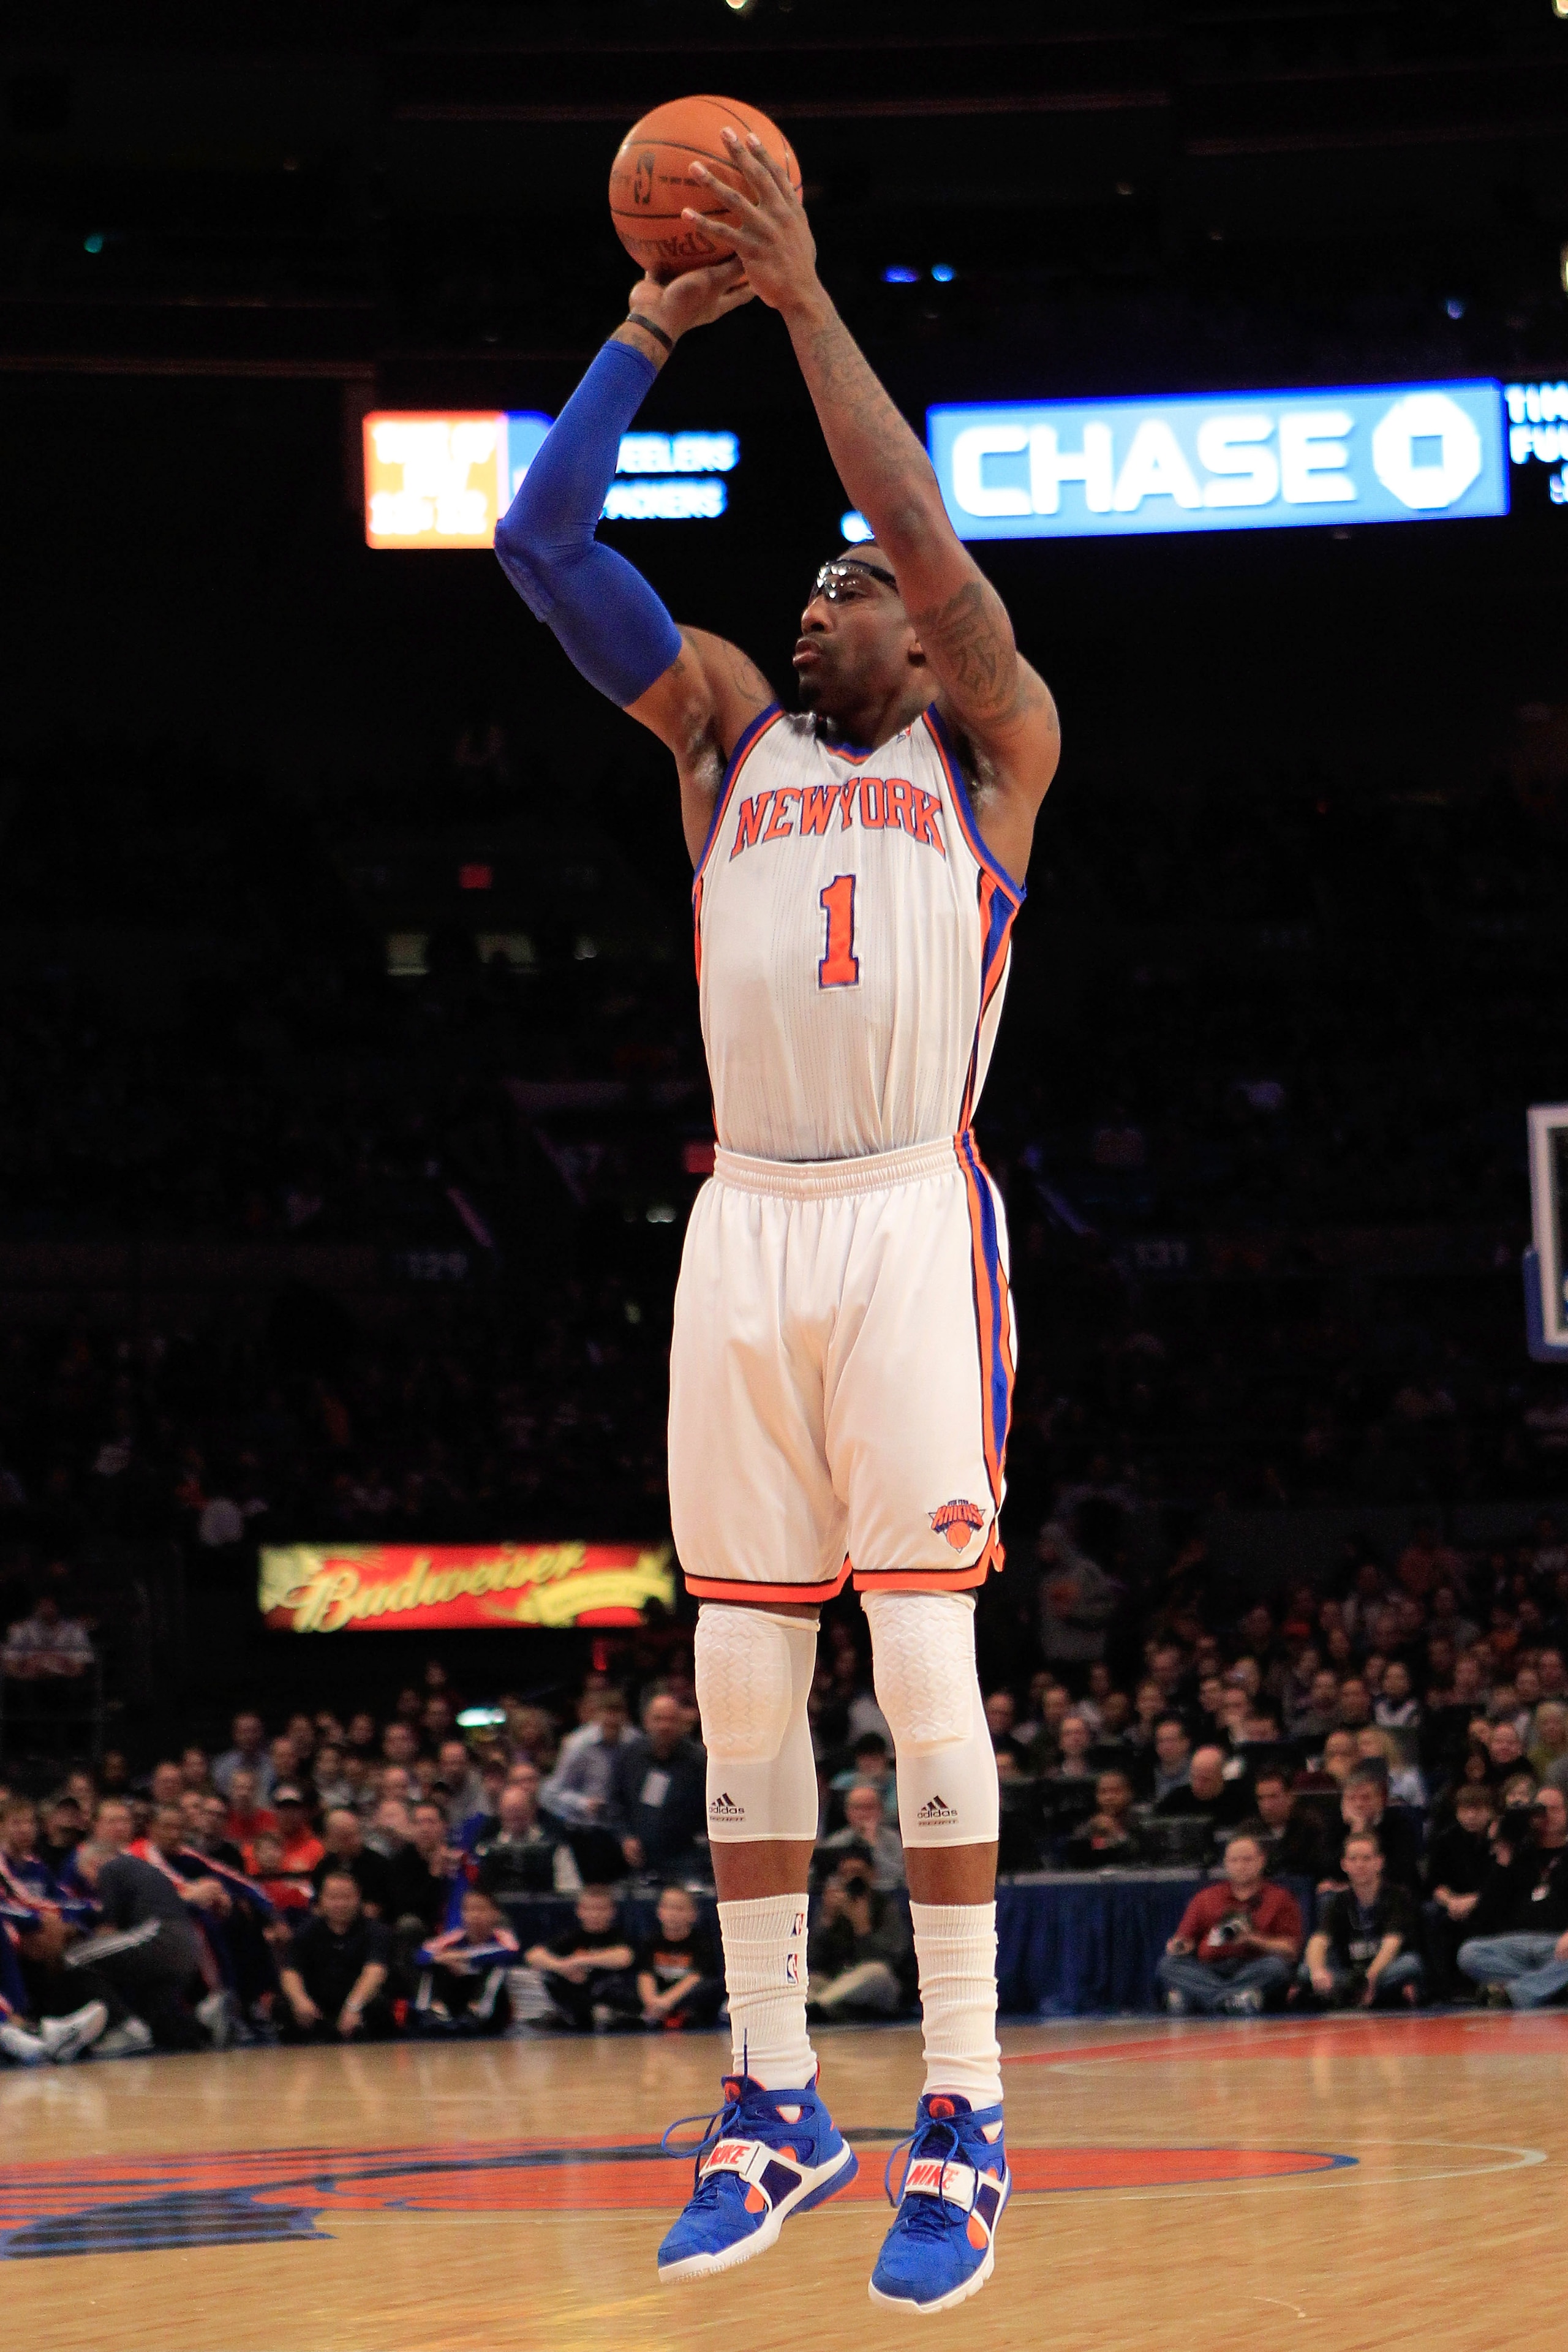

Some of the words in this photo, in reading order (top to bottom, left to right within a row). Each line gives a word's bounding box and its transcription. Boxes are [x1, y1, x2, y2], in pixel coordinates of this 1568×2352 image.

[952, 412, 1357, 518] CHASE
[729, 784, 842, 863] NEW
[839, 777, 947, 863] YORK
[819, 874, 859, 989] 1
[930, 1503, 984, 1532] KNICKS
[286, 1543, 587, 1634] Budweiser
[917, 1809, 958, 1819] adidas
[706, 2145, 751, 2169] NIKE
[906, 2165, 960, 2190] NIKE
